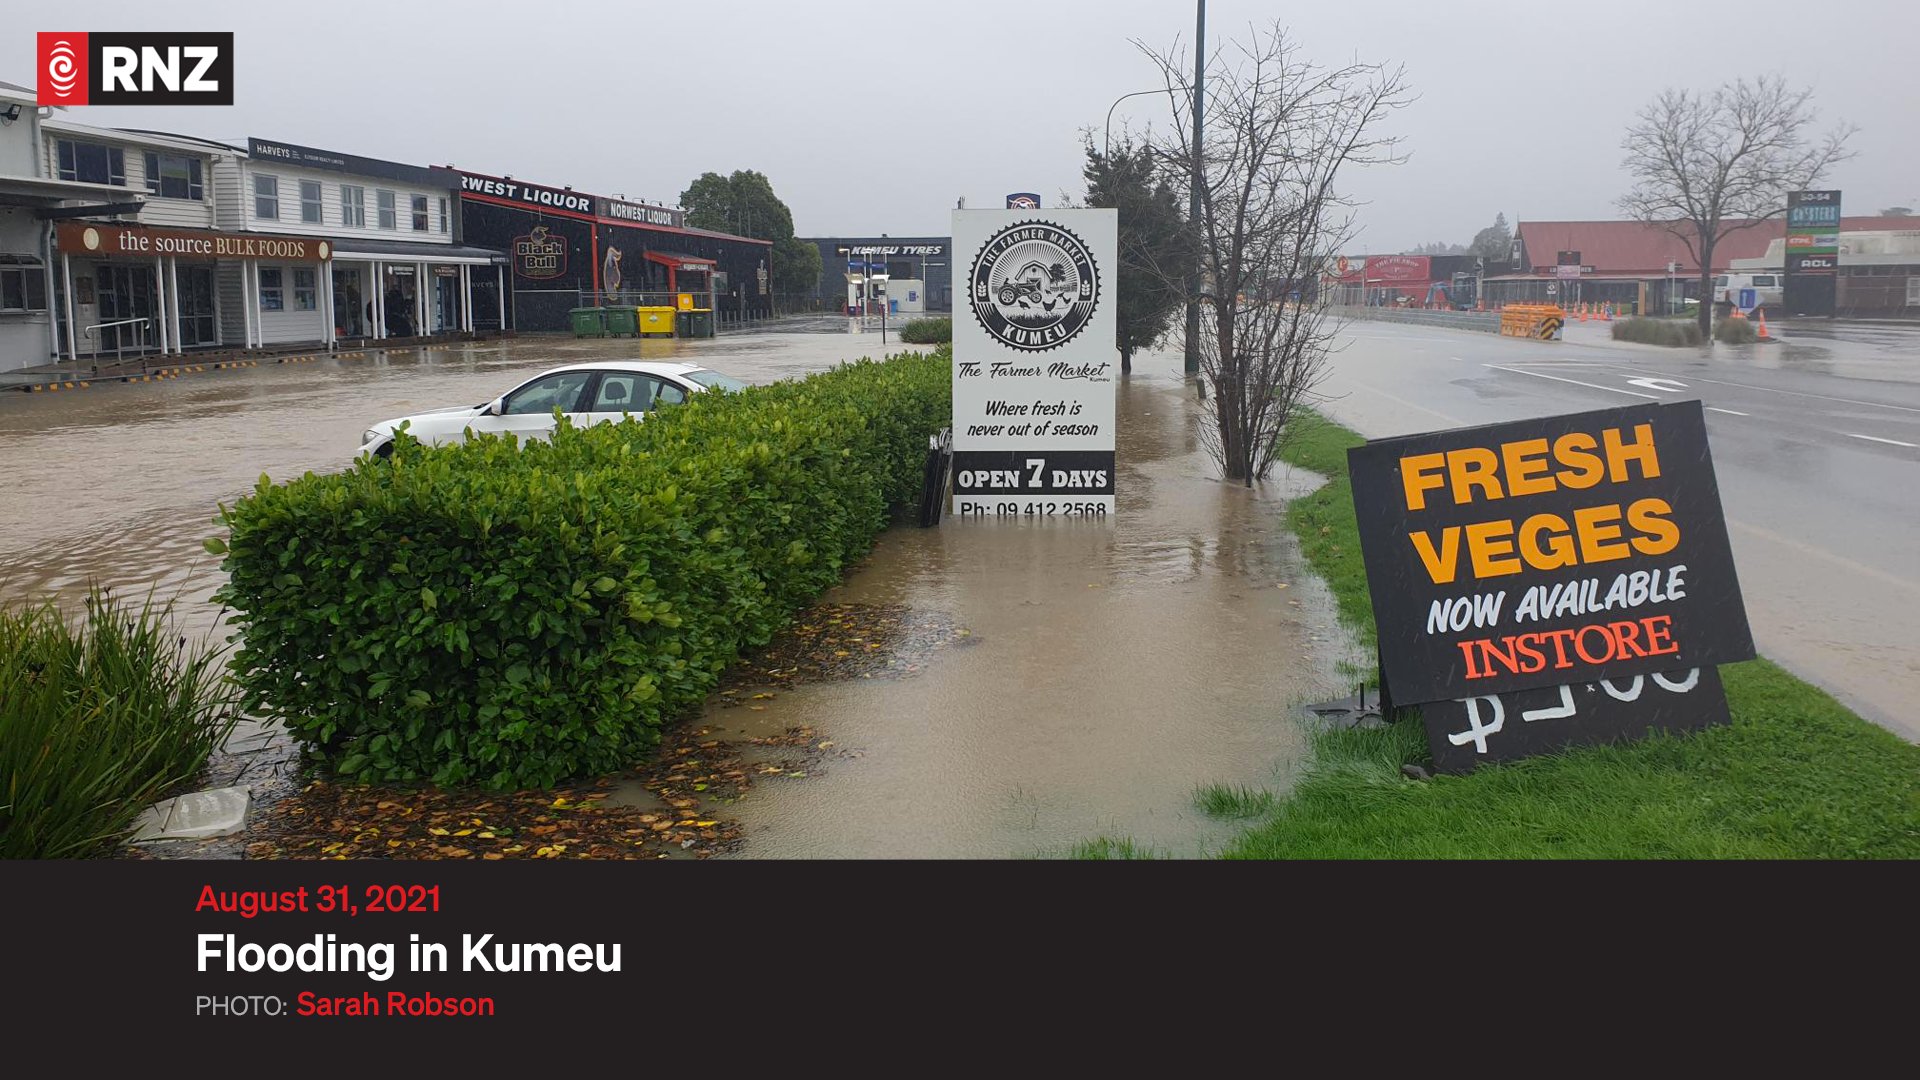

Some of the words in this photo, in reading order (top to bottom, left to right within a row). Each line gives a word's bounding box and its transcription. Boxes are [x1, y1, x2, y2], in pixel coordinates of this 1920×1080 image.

[256, 143, 290, 158] HARVEYS
[523, 187, 590, 212] LIQUOR
[610, 202, 646, 221] NORWEST
[647, 209, 672, 226] LIQUOR
[119, 231, 149, 251] the
[155, 236, 212, 254] source
[215, 237, 255, 256] BULK
[258, 240, 305, 258] FOODS
[517, 241, 563, 255] Black
[851, 246, 899, 254] KUMEU
[902, 246, 942, 254] TYRES
[982, 245, 1000, 267] THE
[1000, 228, 1045, 249] FARMER
[1049, 232, 1087, 266] MARKET
[525, 255, 557, 268] Bull
[1002, 323, 1067, 345] KUMEU
[958, 361, 983, 379] The
[989, 361, 1042, 379] Farmer
[1047, 361, 1111, 380] Market
[985, 400, 1028, 416] Where
[1031, 400, 1066, 416] fresh
[1069, 400, 1082, 416] is
[967, 424, 1005, 436] never
[1008, 423, 1031, 436] out
[1034, 420, 1051, 436] of
[1051, 424, 1098, 436] season
[958, 470, 1020, 488] OPEN
[1026, 458, 1046, 488] 7
[1052, 470, 1107, 488] DAYS
[1399, 423, 1661, 511] FRESH
[960, 502, 991, 515] Ph:
[996, 502, 1018, 515] 09
[1024, 502, 1056, 515] 412
[1062, 502, 1106, 515] 2568
[1409, 498, 1680, 585] VEGES
[1427, 591, 1506, 635] NOW
[1515, 564, 1688, 623] AVAILABLE
[1457, 615, 1679, 680] INSTORE
